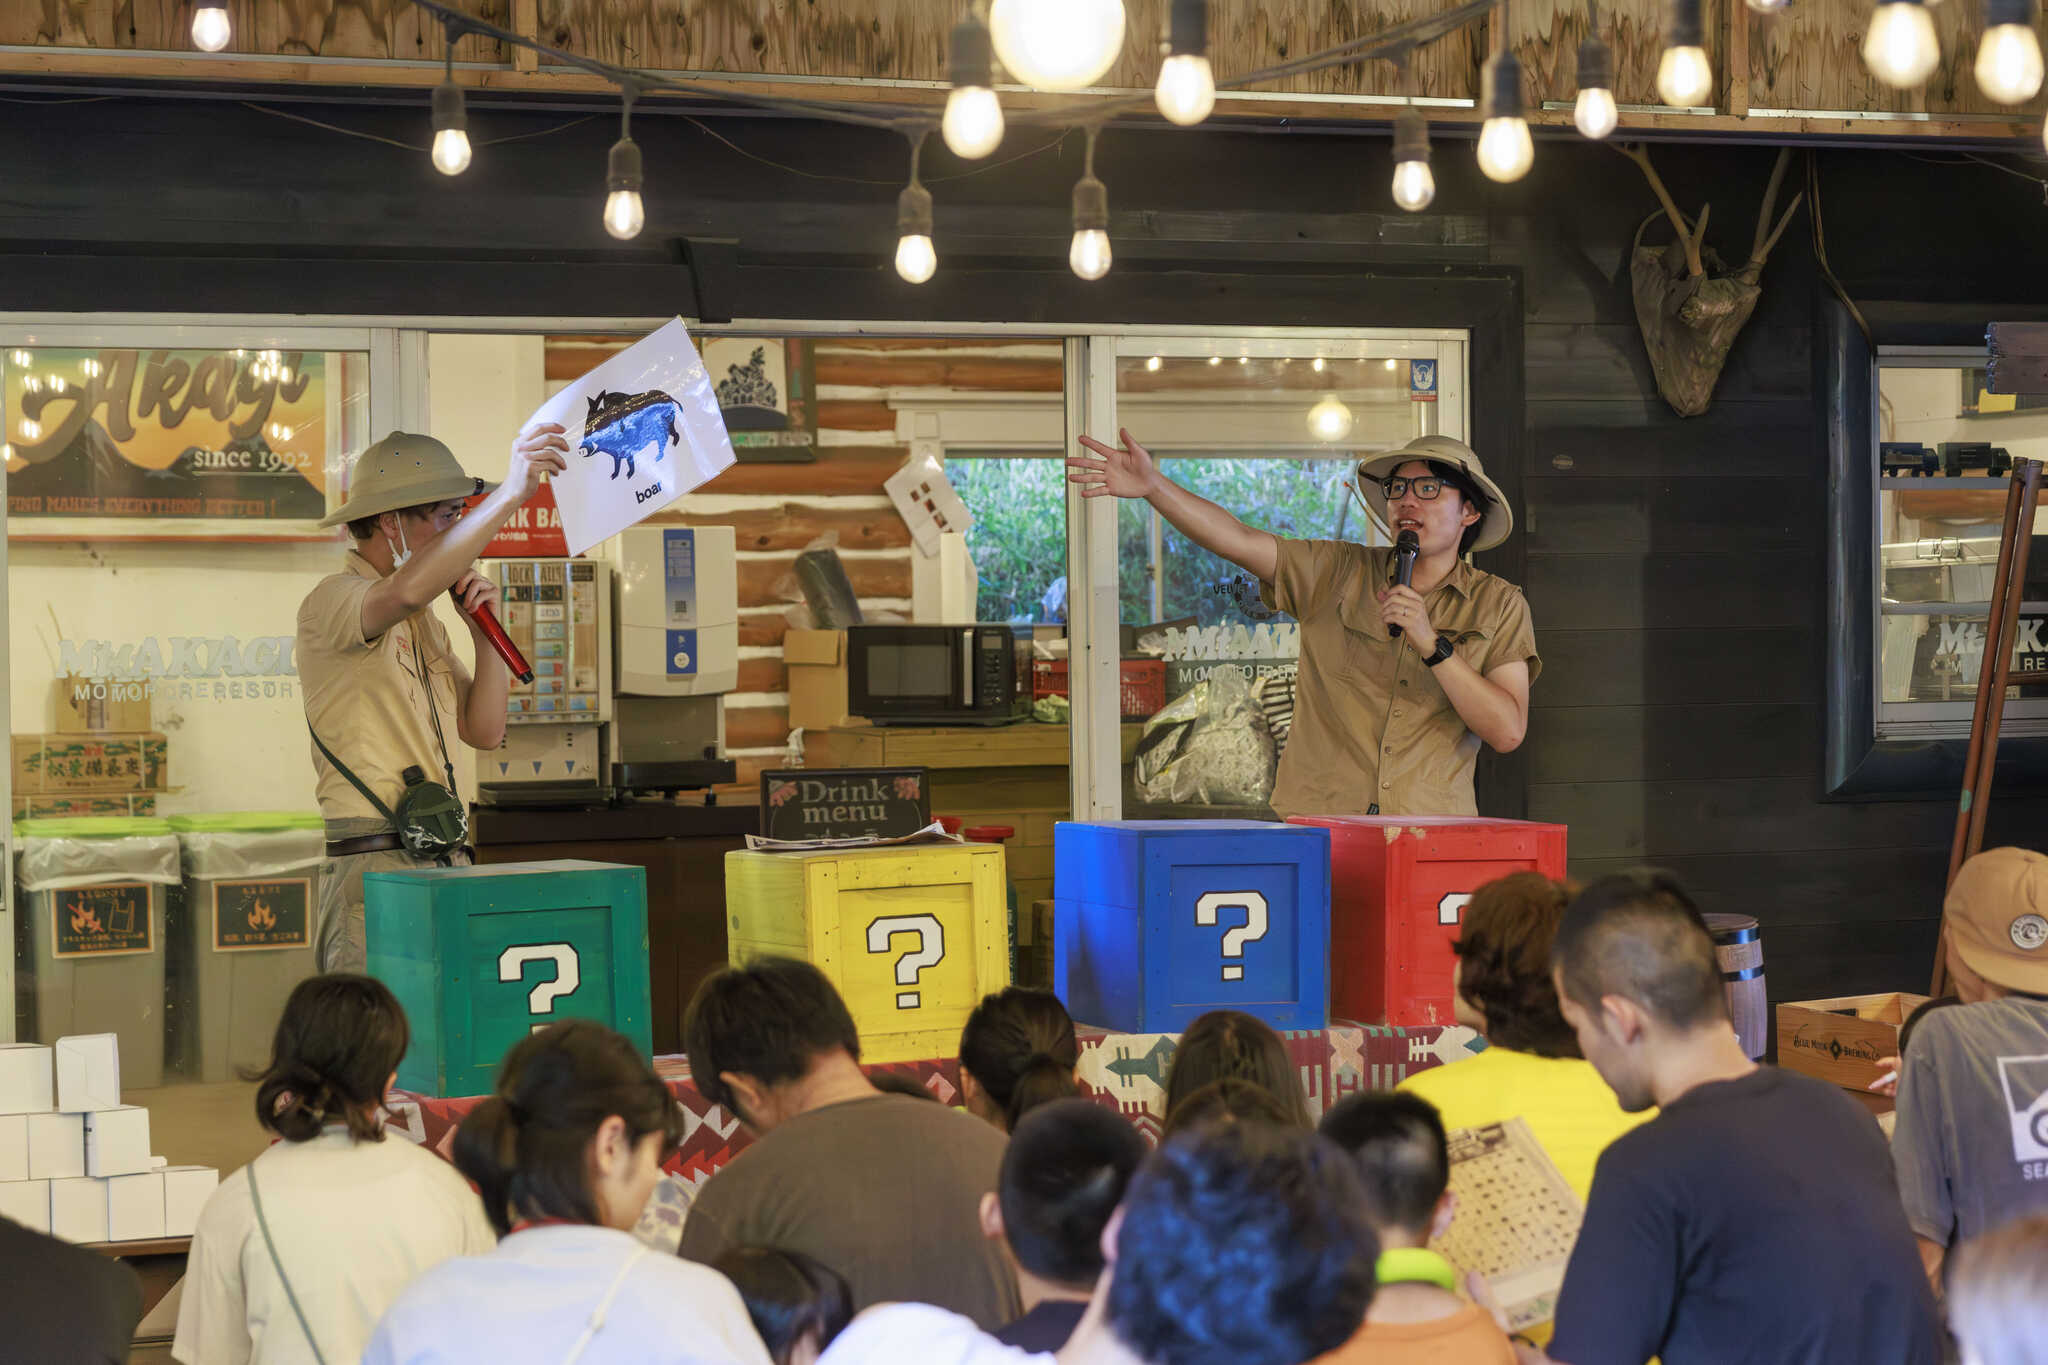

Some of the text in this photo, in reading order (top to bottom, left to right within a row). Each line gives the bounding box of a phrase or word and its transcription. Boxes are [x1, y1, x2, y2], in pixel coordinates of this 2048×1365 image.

[194, 447, 312, 472] since 1992
[536, 507, 562, 529] BA
[800, 778, 888, 803] Drink
[803, 804, 888, 824] menu
